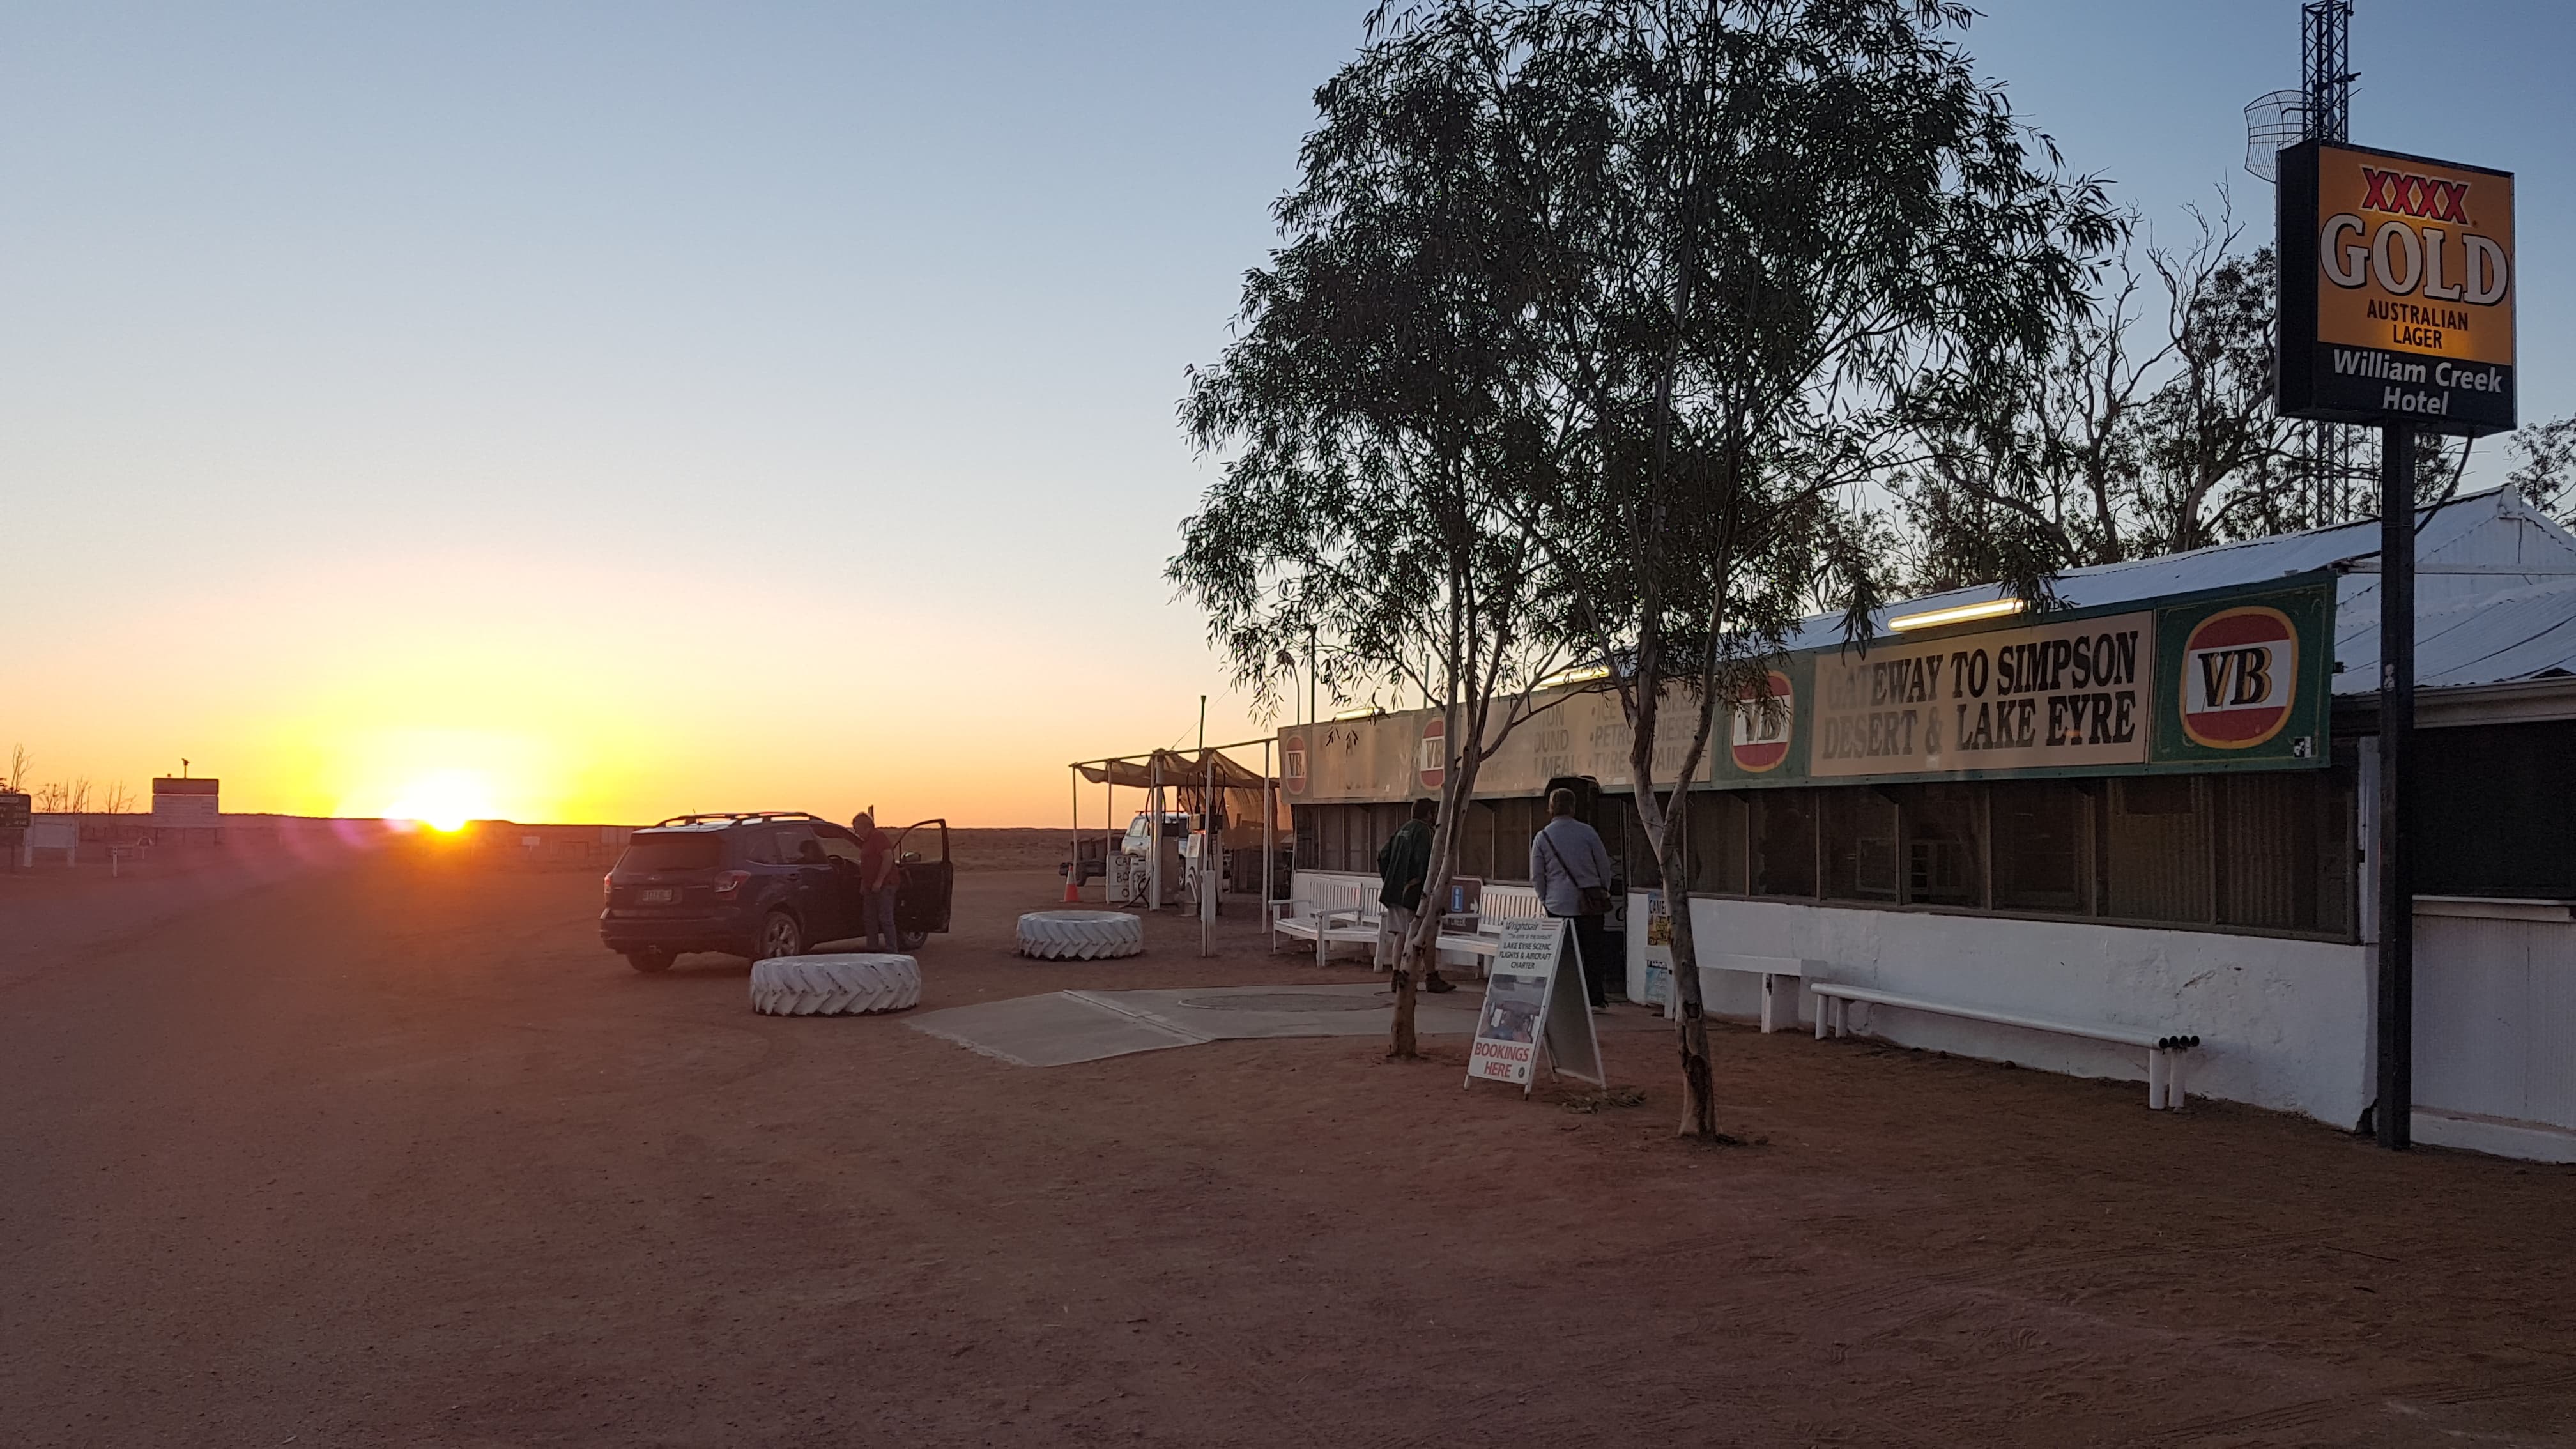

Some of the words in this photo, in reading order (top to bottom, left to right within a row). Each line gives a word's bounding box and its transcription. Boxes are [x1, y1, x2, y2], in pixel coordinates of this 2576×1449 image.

[2360, 166, 2471, 225] XXXX
[2320, 213, 2509, 306] GOLD
[2366, 299, 2469, 331] AUSTRALIAN
[2393, 324, 2442, 349] LAGER
[2333, 349, 2426, 383] William
[2435, 362, 2503, 394] Creek
[2382, 385, 2450, 415] Hotel
[1828, 654, 1943, 710] GATEWAY
[1950, 648, 1988, 699] TO
[1997, 631, 2139, 696] SIMPSON
[2198, 647, 2272, 707] VB
[1822, 709, 1917, 759] DESERT
[1924, 706, 1943, 756] &
[1955, 698, 2036, 751] LAKE
[2046, 690, 2136, 747] EYRE
[1475, 1042, 1530, 1062] BOOKINGS
[1484, 1061, 1512, 1078] HERE
